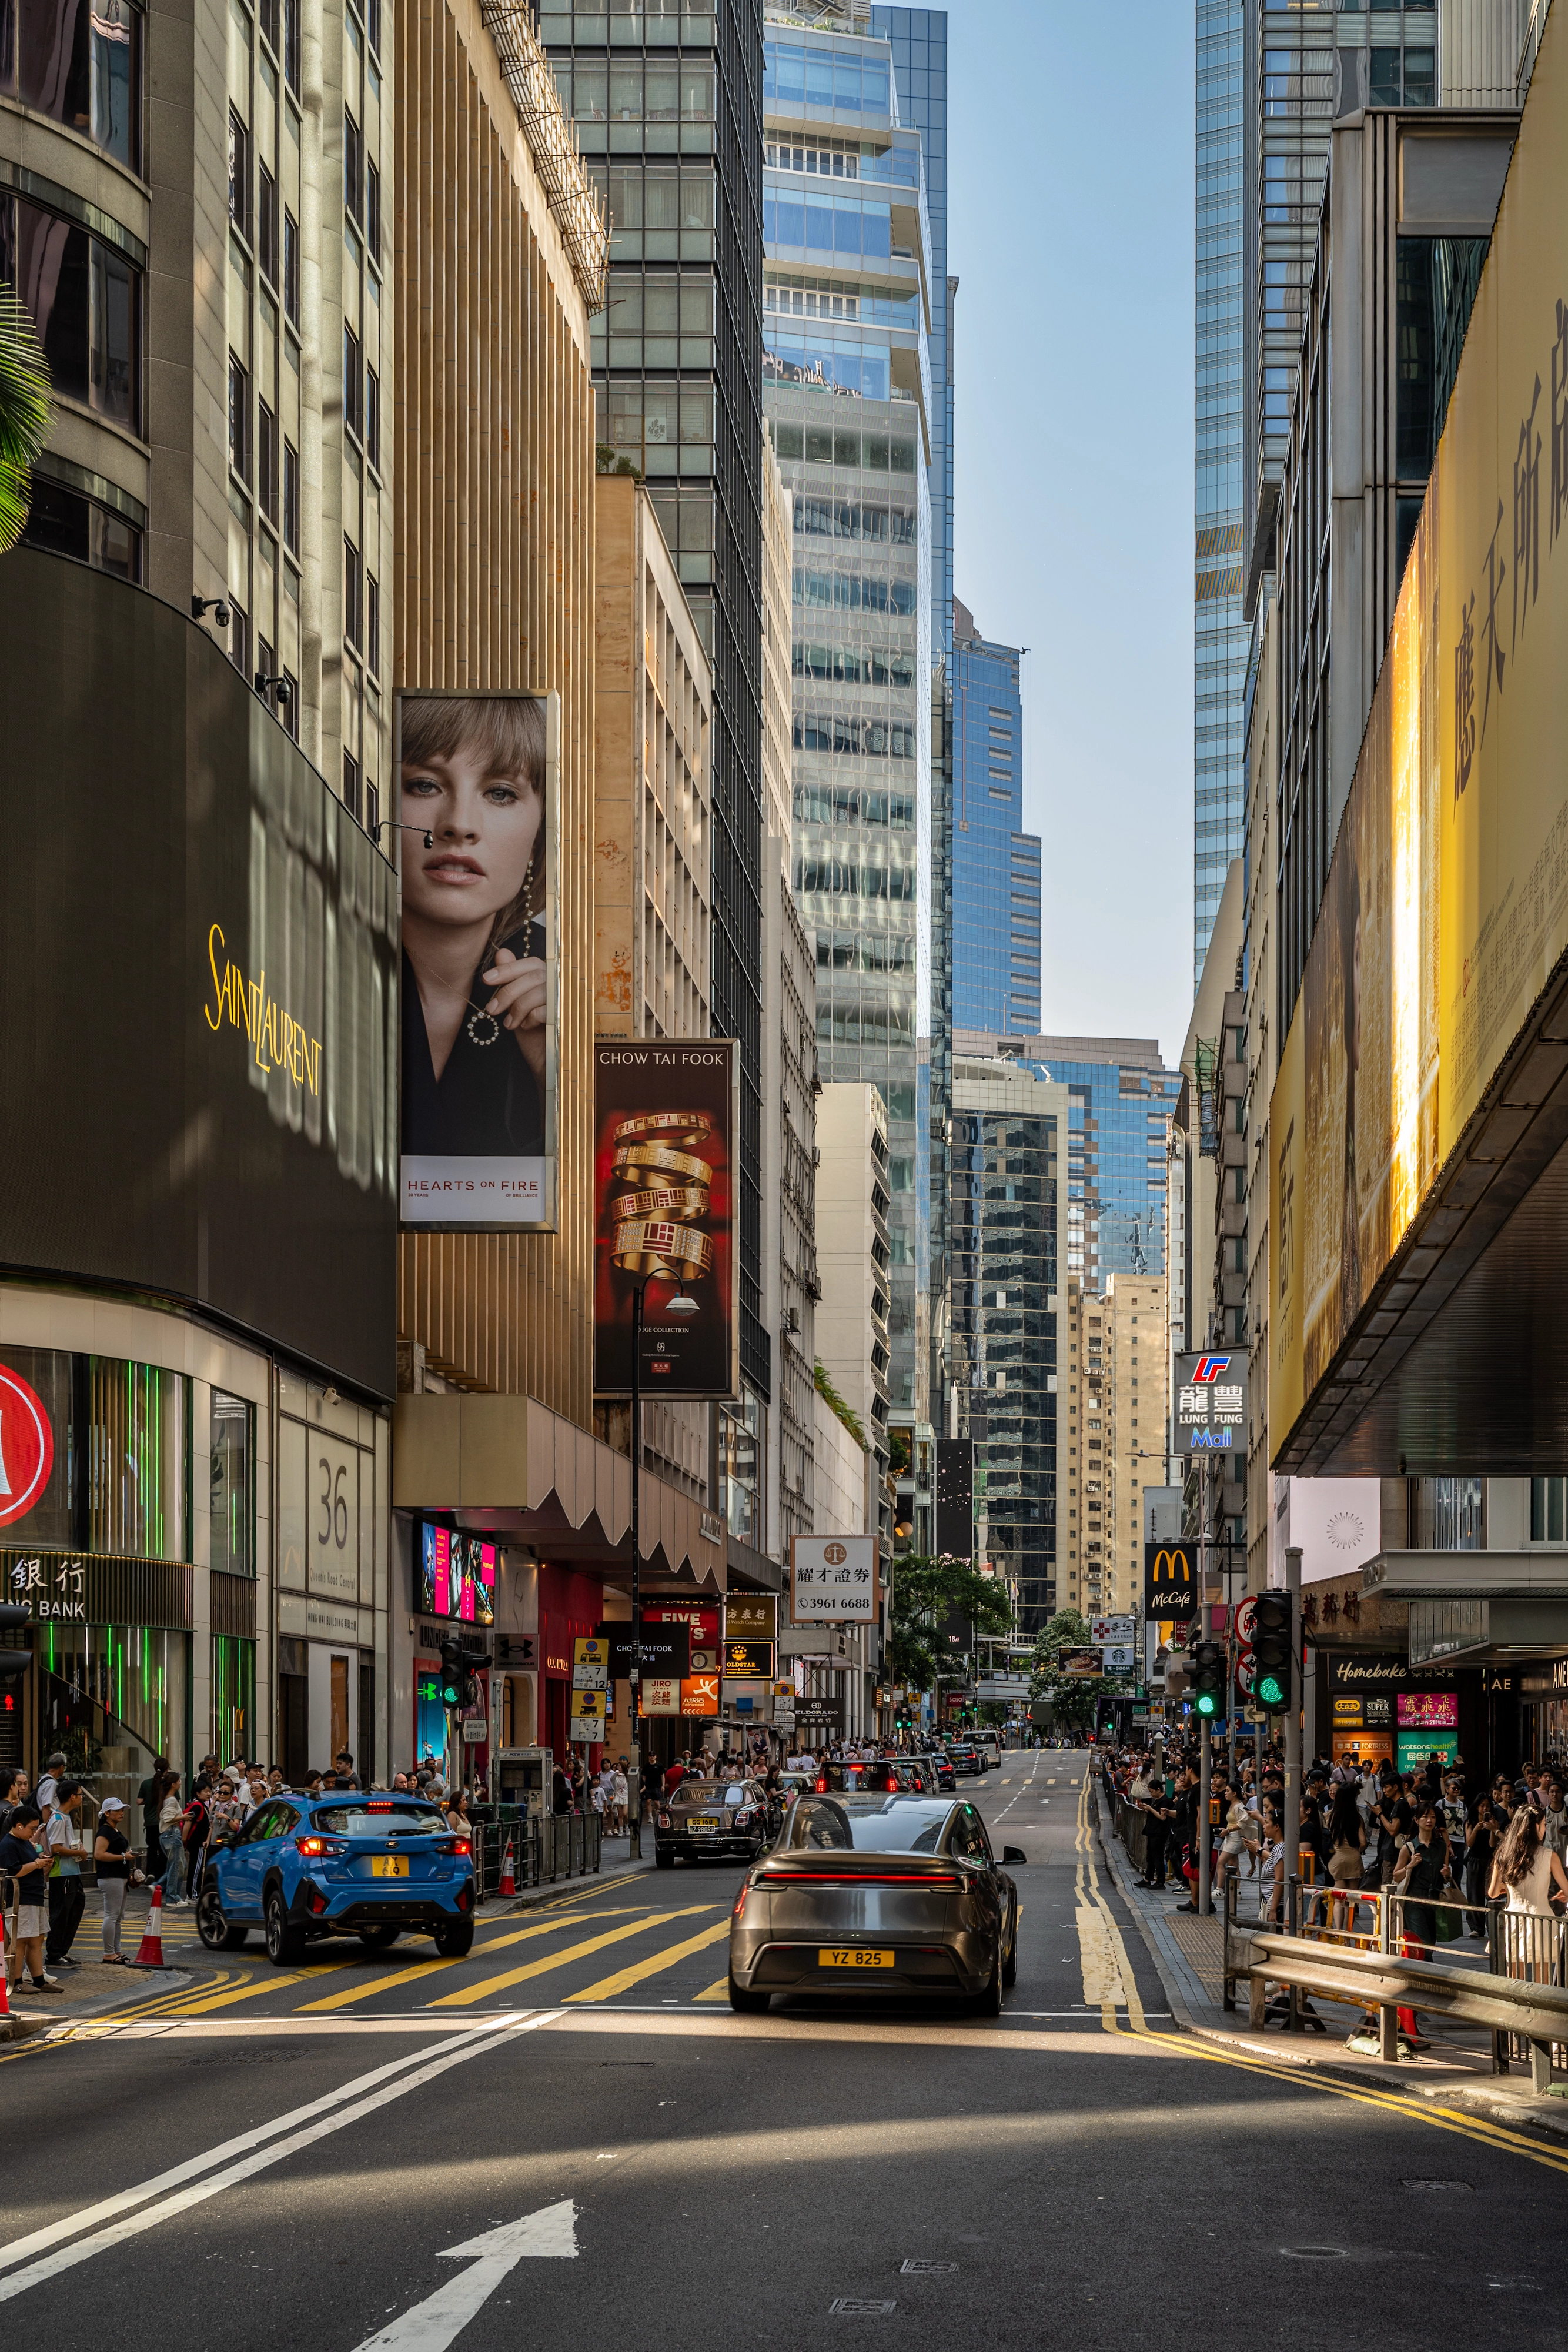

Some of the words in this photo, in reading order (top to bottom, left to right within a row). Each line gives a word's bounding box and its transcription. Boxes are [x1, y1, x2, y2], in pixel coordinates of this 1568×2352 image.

[205, 924, 261, 1043] SAINT
[256, 970, 322, 1096] LAURENT
[600, 1053, 648, 1064] CHOW
[653, 1053, 675, 1064] TAI
[682, 1053, 723, 1065] FOOK
[408, 1181, 474, 1190] HEARTS
[502, 1181, 538, 1190] FIRE
[1179, 1385, 1243, 1413] 龍豐
[1179, 1415, 1208, 1424] LUNG
[1214, 1415, 1243, 1424] FUNG
[1191, 1426, 1232, 1448] Mall
[318, 1458, 347, 1549] 36
[10, 1558, 85, 1593] 銀行
[310, 1568, 326, 1583] Queen's
[327, 1572, 338, 1586] Road
[339, 1575, 355, 1589] Central
[797, 1568, 870, 1583] 耀才證券
[810, 1598, 835, 1608] 3961
[841, 1598, 870, 1608] 6688
[1152, 1591, 1191, 1608] McCafé
[39, 1601, 85, 1618] BANK
[308, 1613, 317, 1623] HING
[326, 1616, 343, 1627] BUILDING
[662, 1613, 700, 1626] FIVE
[422, 1626, 449, 1649] UNDE
[595, 1667, 601, 1675] 7
[1336, 1662, 1407, 1682] Homebake
[1553, 1660, 1568, 1689] AME
[594, 1680, 605, 1688] 12
[1492, 1679, 1512, 1690] AE
[651, 1690, 671, 1699] 次郎
[832, 1952, 850, 1964] YZ
[855, 1952, 881, 1965] 825
